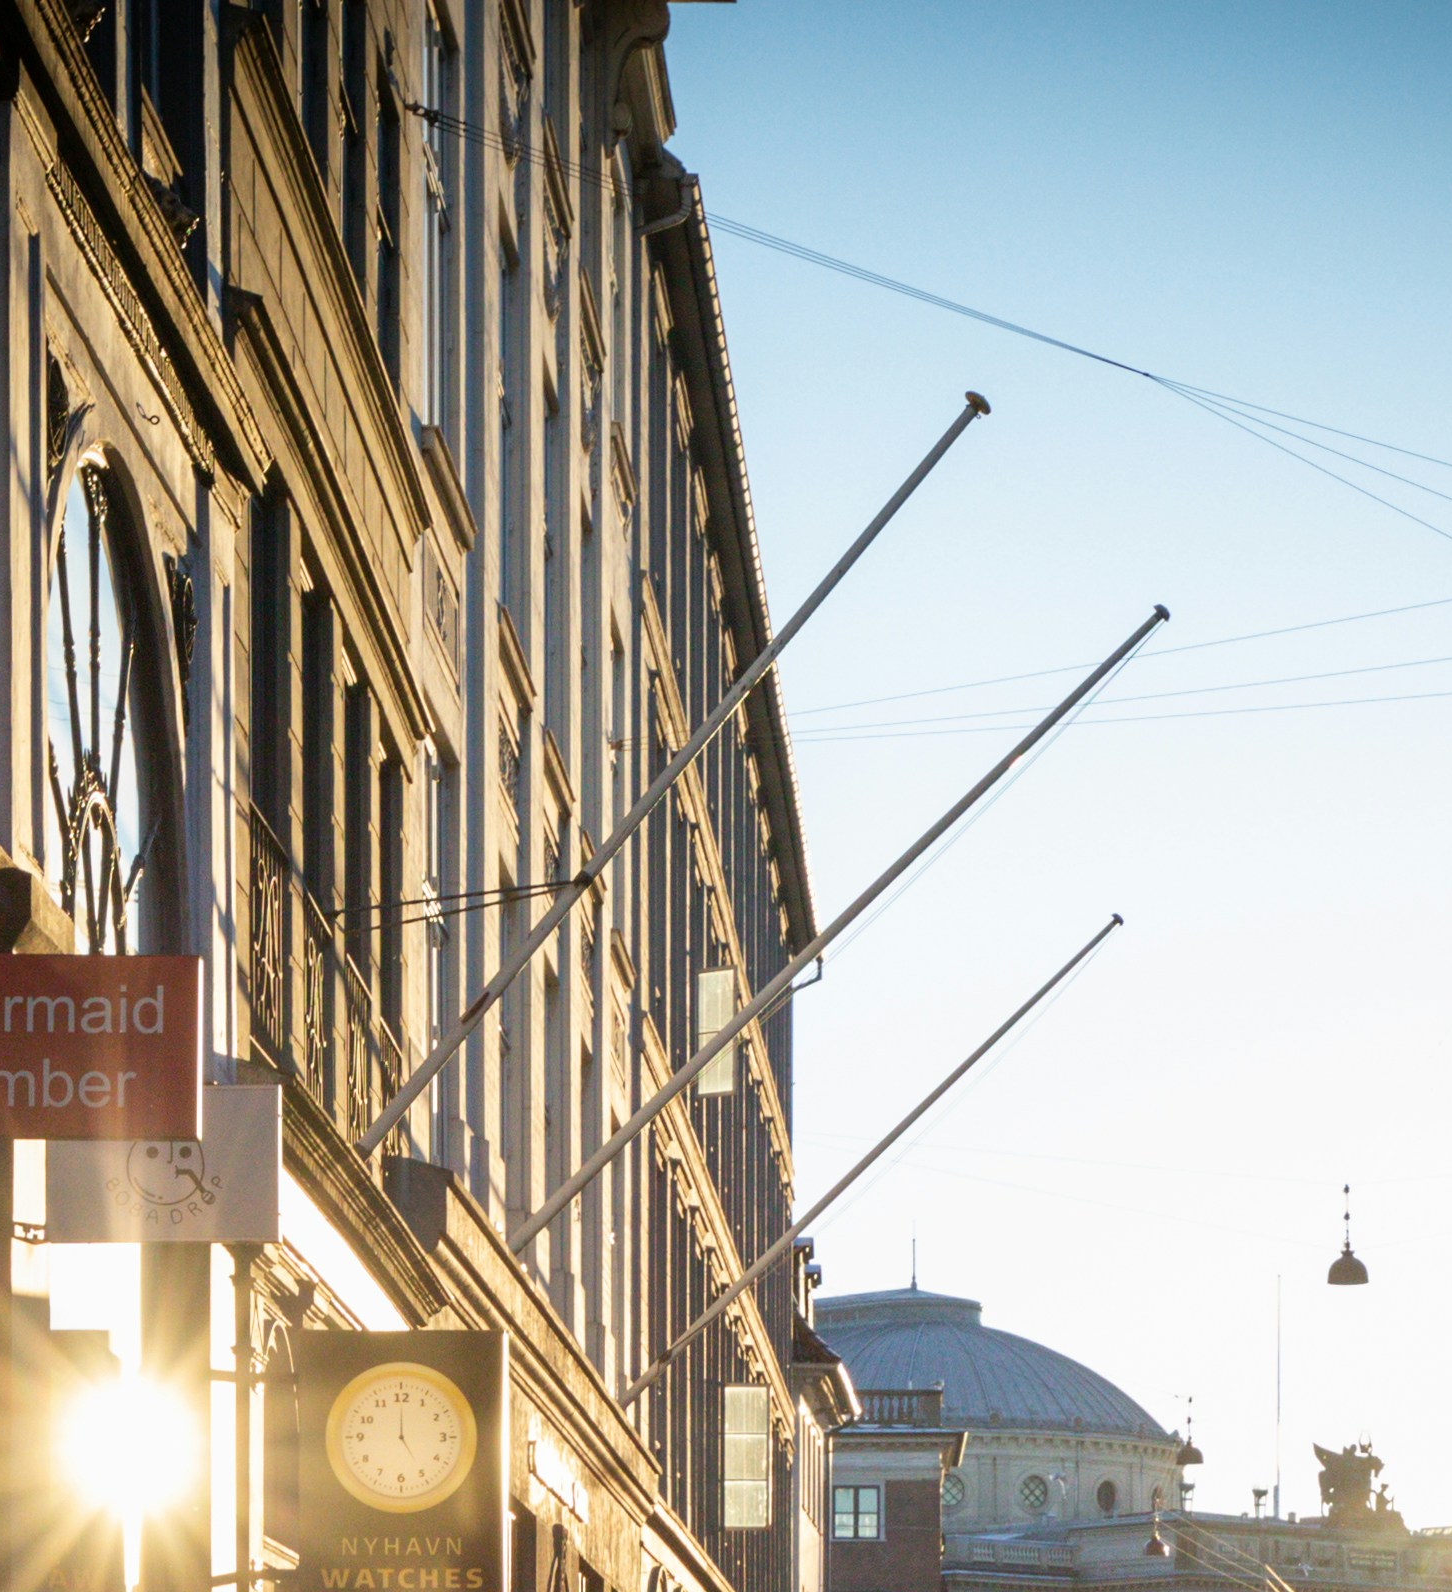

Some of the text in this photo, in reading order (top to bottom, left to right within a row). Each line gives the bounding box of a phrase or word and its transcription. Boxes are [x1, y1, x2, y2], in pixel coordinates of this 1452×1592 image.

[393, 1393, 409, 1403] 12
[374, 1399, 387, 1408] 11
[419, 1399, 425, 1407] 1
[360, 1416, 373, 1425] 10
[433, 1413, 440, 1422] 2
[356, 1432, 365, 1442] 9
[439, 1432, 447, 1442] 3
[362, 1455, 369, 1463] 8
[433, 1453, 441, 1462] 4
[377, 1468, 383, 1476] 7
[418, 1469, 425, 1478] 5
[397, 1473, 405, 1483] 6
[340, 1536, 463, 1557] NYHAVN
[320, 1567, 484, 1590] WATCHES
